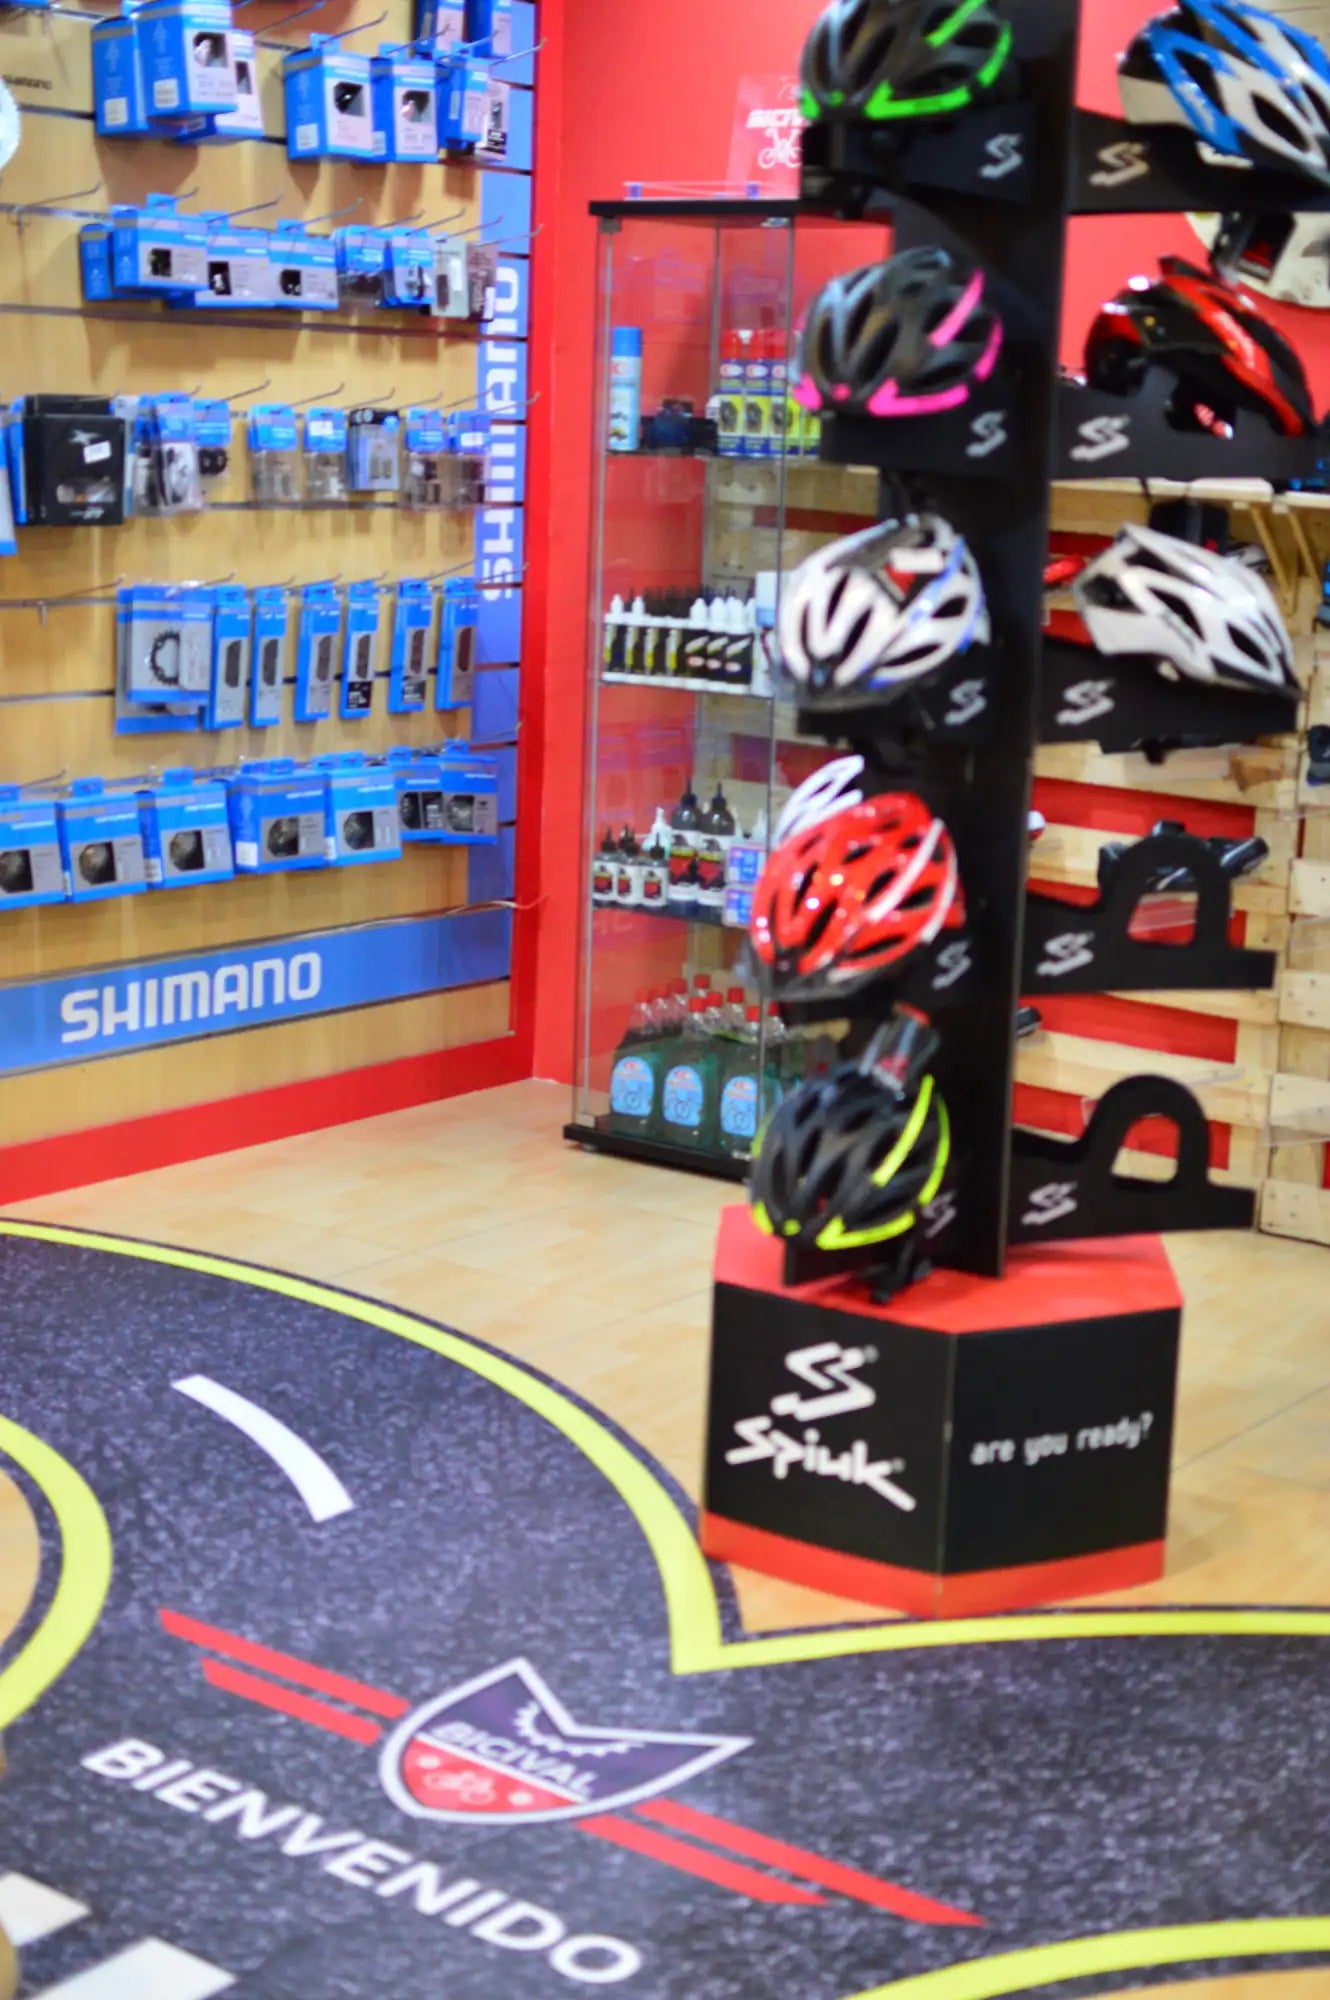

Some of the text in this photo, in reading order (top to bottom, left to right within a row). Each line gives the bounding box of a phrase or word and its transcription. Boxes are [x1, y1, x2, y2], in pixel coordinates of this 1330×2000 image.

[61, 952, 322, 1043] SHIMANO
[970, 1411, 1154, 1466] are you ready?
[430, 1720, 599, 1801] BICIVAL
[81, 1738, 643, 1984] BIENVENIDO
